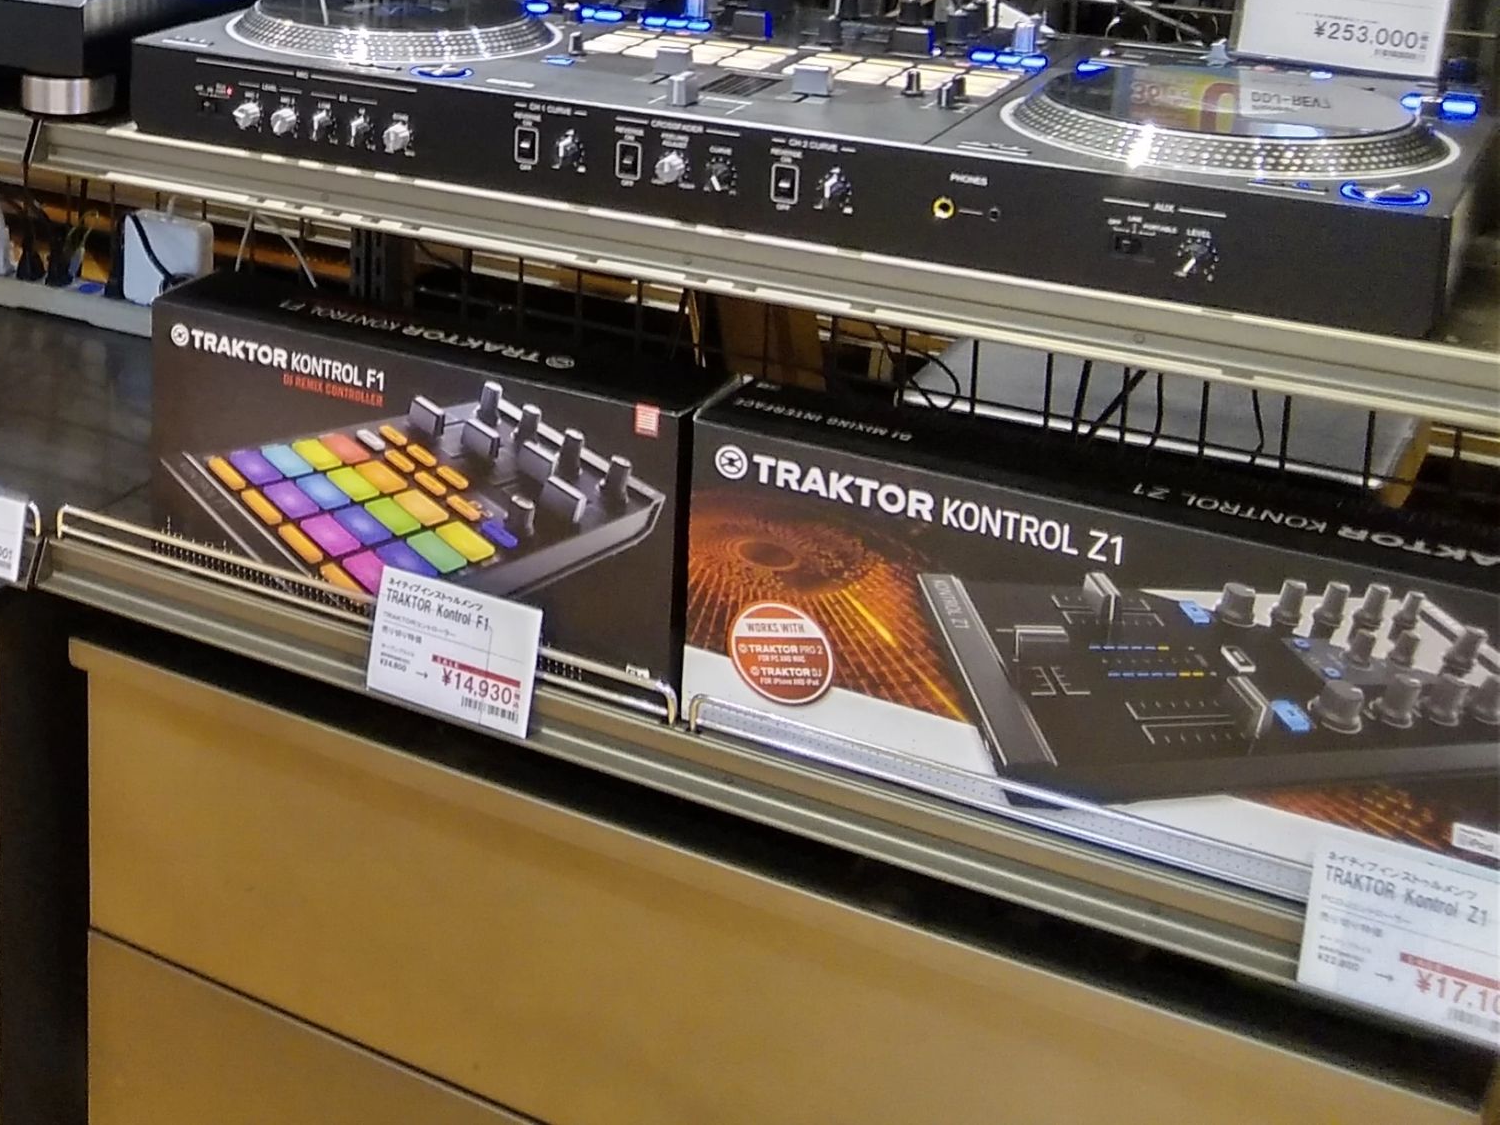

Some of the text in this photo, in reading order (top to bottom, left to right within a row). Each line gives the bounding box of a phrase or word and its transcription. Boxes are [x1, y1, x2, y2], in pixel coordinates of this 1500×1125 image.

[1313, 20, 1419, 50] ¥253,000
[650, 120, 704, 134] CROSSFADER
[950, 173, 988, 187] PHONES
[1153, 202, 1175, 213] AUX
[1186, 227, 1212, 238] LEVEL
[402, 323, 540, 363] TRAKTOR
[191, 329, 385, 392] TRAKTOR KONTROL F1
[294, 376, 324, 393] REMIX
[325, 382, 384, 407] CONTROLLER
[826, 416, 888, 437] MIXING
[1132, 481, 1169, 500] Z1
[752, 452, 1125, 567] TRAKTOR KONTROL Z1
[1181, 492, 1328, 534] KONTROL
[386, 588, 490, 631] TRAKTOR Kontrol F1
[746, 623, 805, 633] WORKS WITH
[748, 644, 823, 655] TRAKTOR PRO 2
[760, 667, 810, 677] TRAKTOR
[441, 667, 513, 705] ¥14,930
[1325, 865, 1488, 926] TRAKTOR Kontrol Z1
